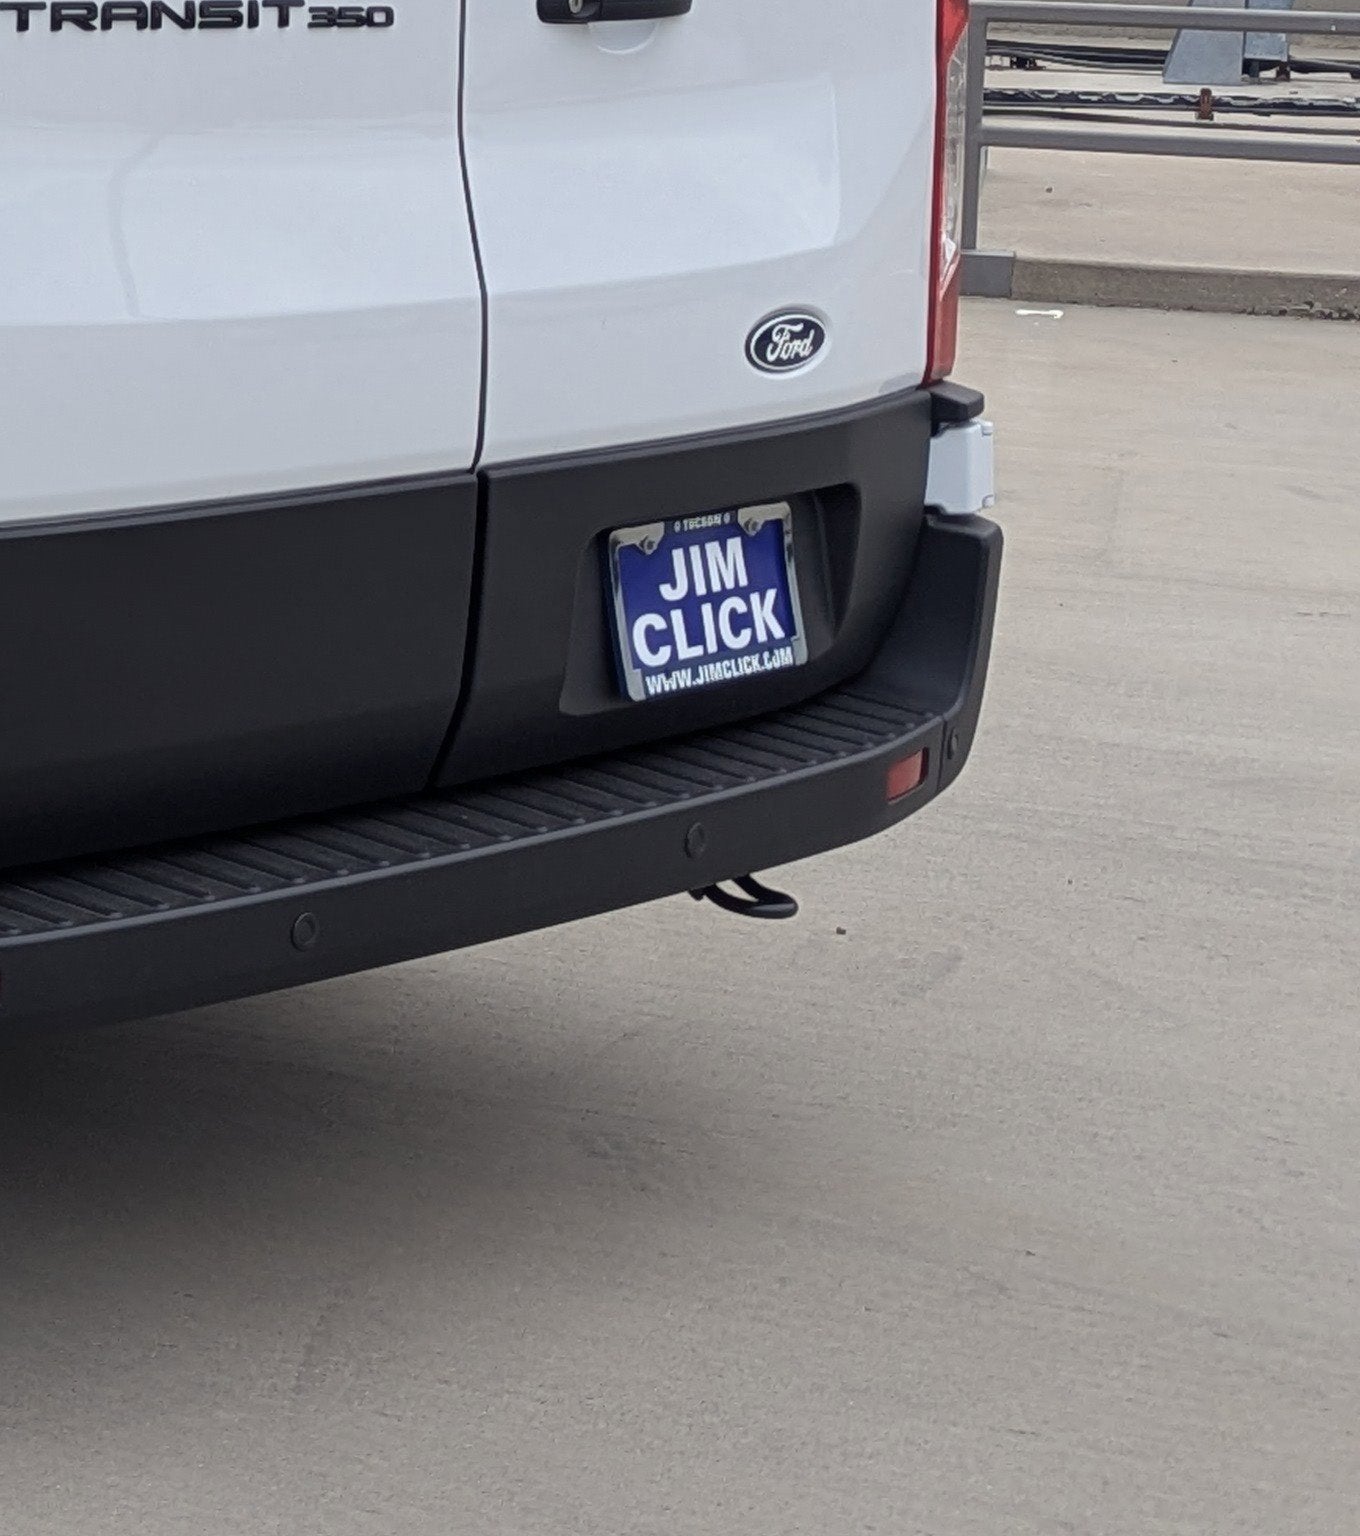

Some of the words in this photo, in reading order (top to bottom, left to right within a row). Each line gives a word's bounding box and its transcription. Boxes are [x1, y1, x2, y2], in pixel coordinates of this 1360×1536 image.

[307, 5, 394, 29] 350
[766, 322, 815, 362] Ford
[659, 536, 749, 601] JIM
[632, 588, 786, 668] CLICK
